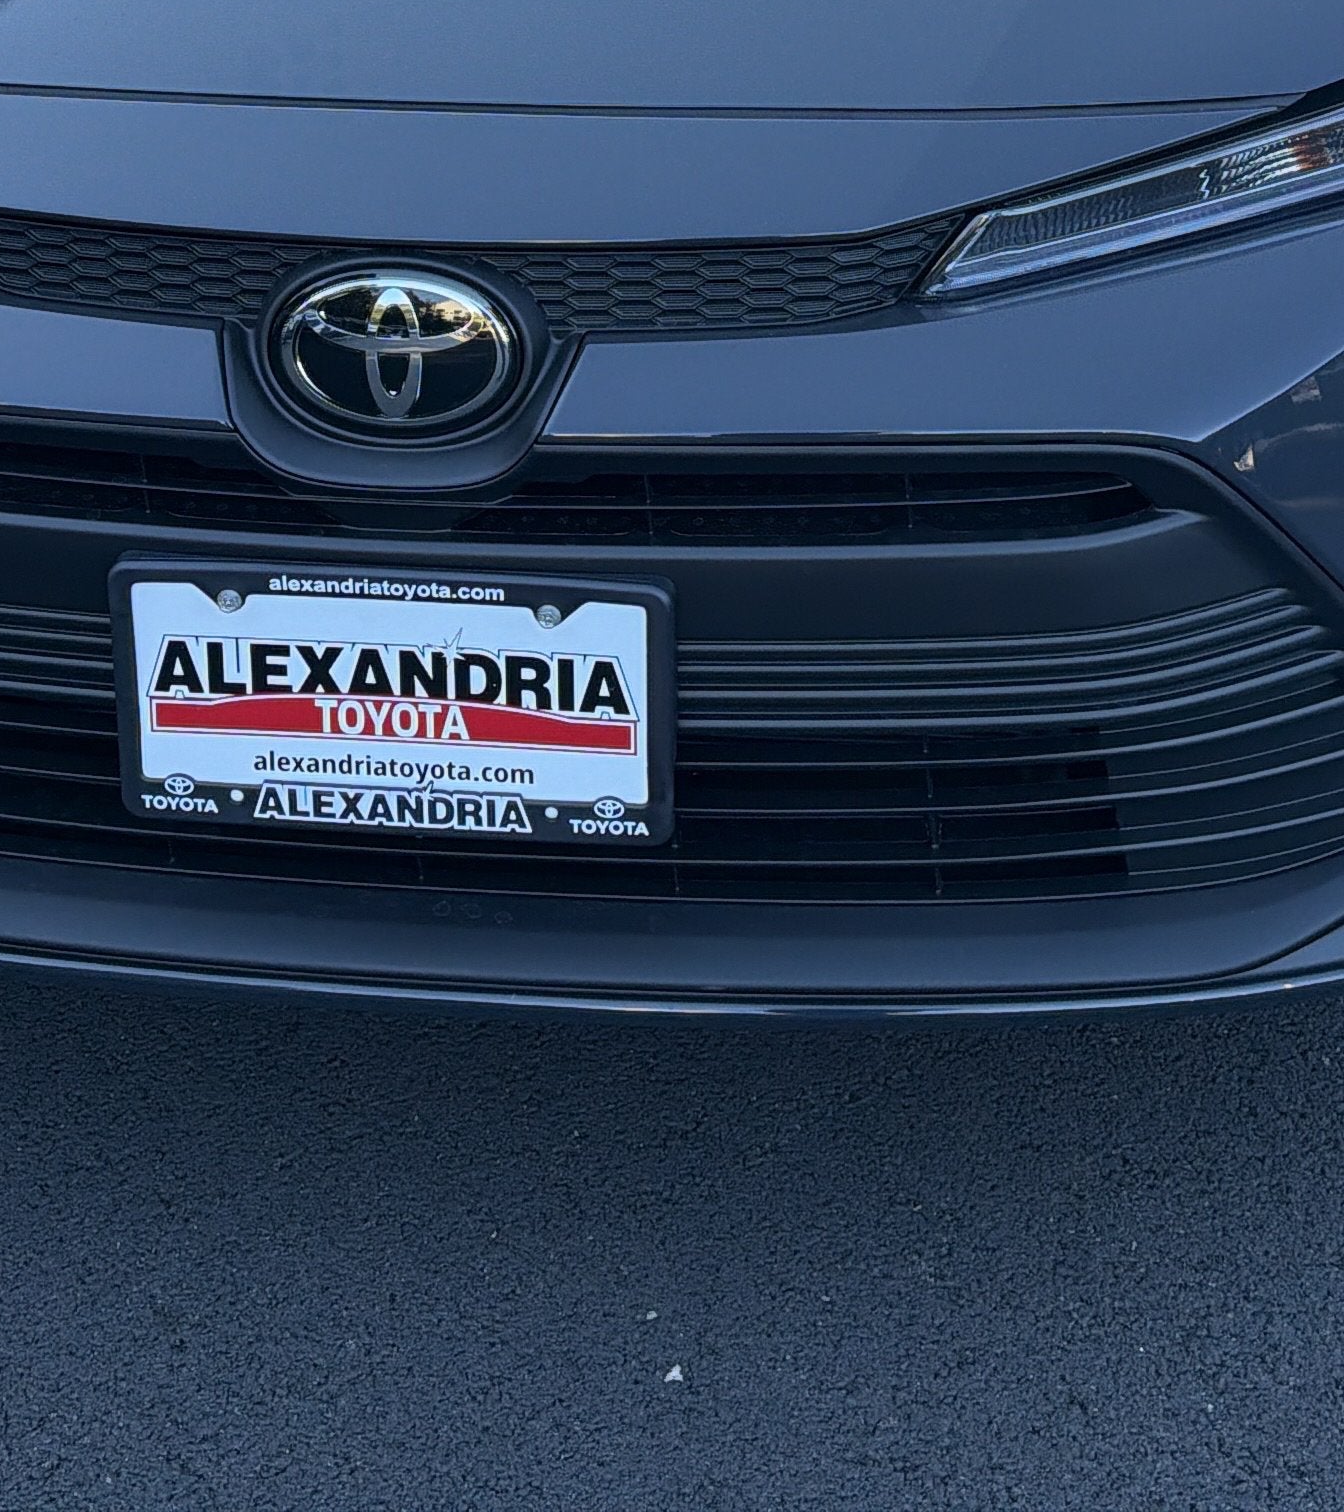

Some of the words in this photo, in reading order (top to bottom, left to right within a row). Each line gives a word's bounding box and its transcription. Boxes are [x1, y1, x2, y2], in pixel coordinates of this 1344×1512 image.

[268, 575, 505, 602] alexandriatoyota.com
[154, 639, 632, 716] ALEXANDRIA
[314, 697, 471, 741] TOYOTA
[253, 751, 535, 785] alexandriatoyota.com
[141, 794, 219, 814] TOYOTA
[255, 784, 532, 833] ALEXANDRIA
[569, 817, 650, 838] TOYOTA
